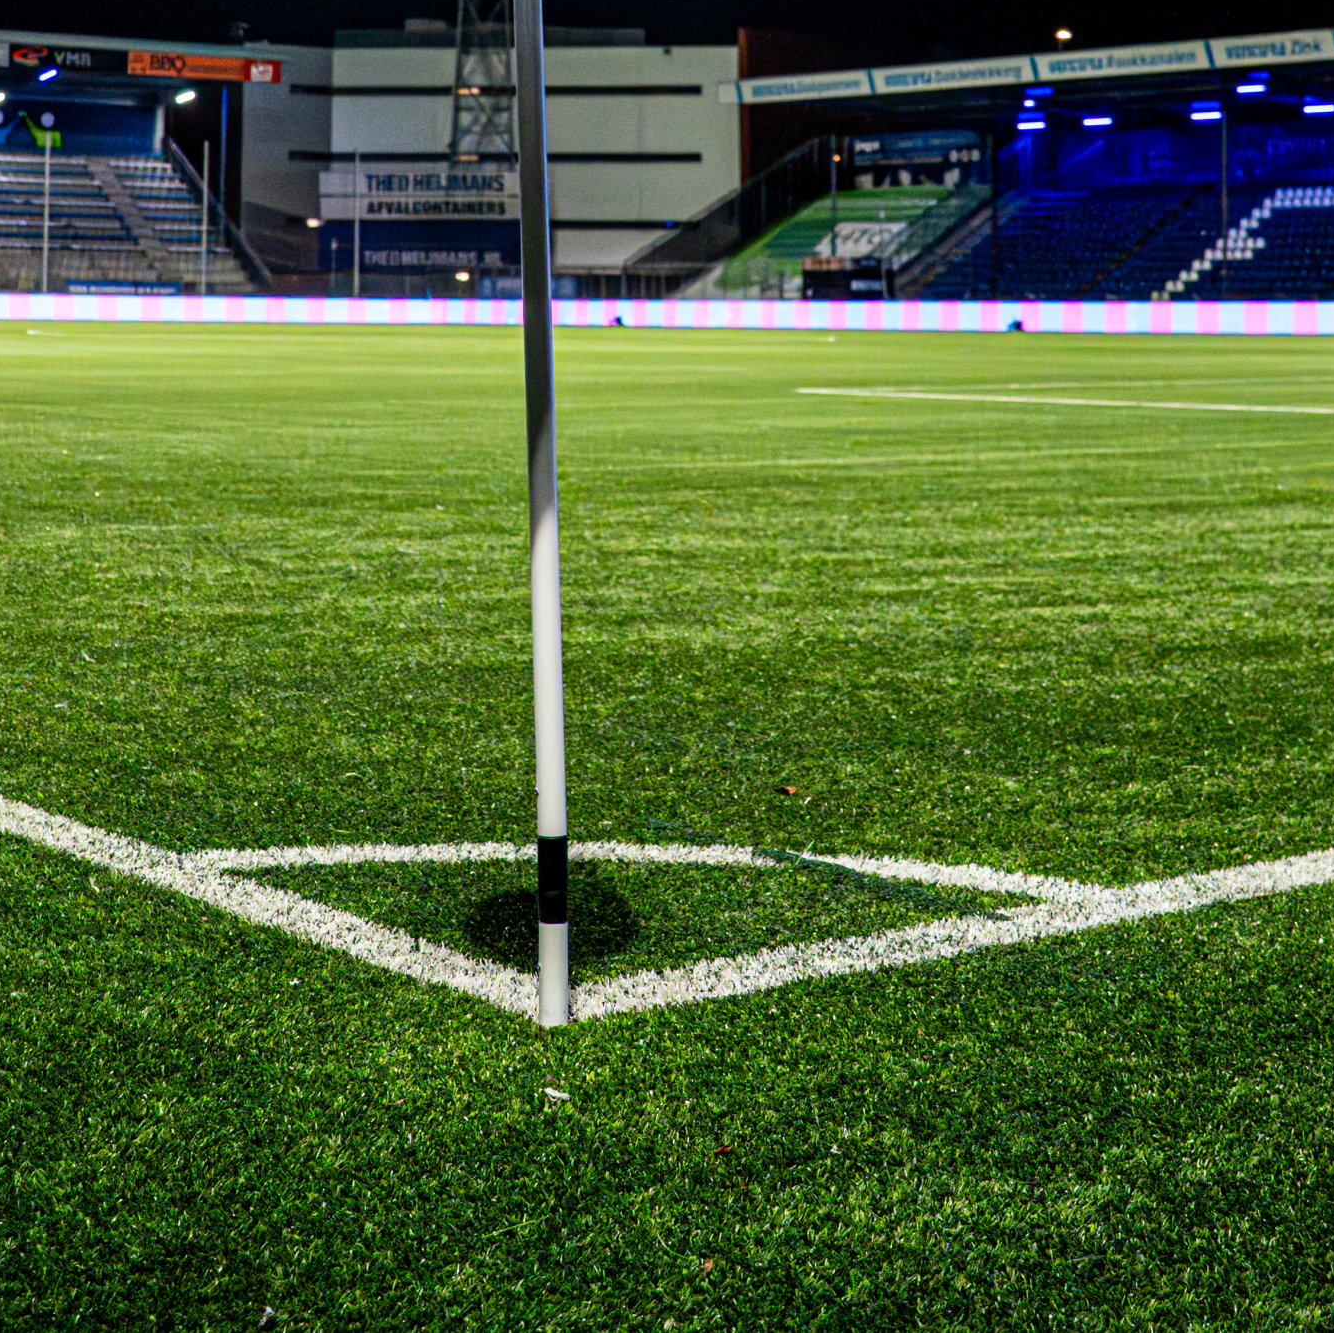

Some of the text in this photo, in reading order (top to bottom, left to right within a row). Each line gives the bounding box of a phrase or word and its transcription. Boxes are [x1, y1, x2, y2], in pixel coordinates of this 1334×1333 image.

[1290, 35, 1322, 56] Zink
[365, 172, 505, 192] THEO HEIJMANS
[367, 200, 507, 215] AFVALCONTAINERS
